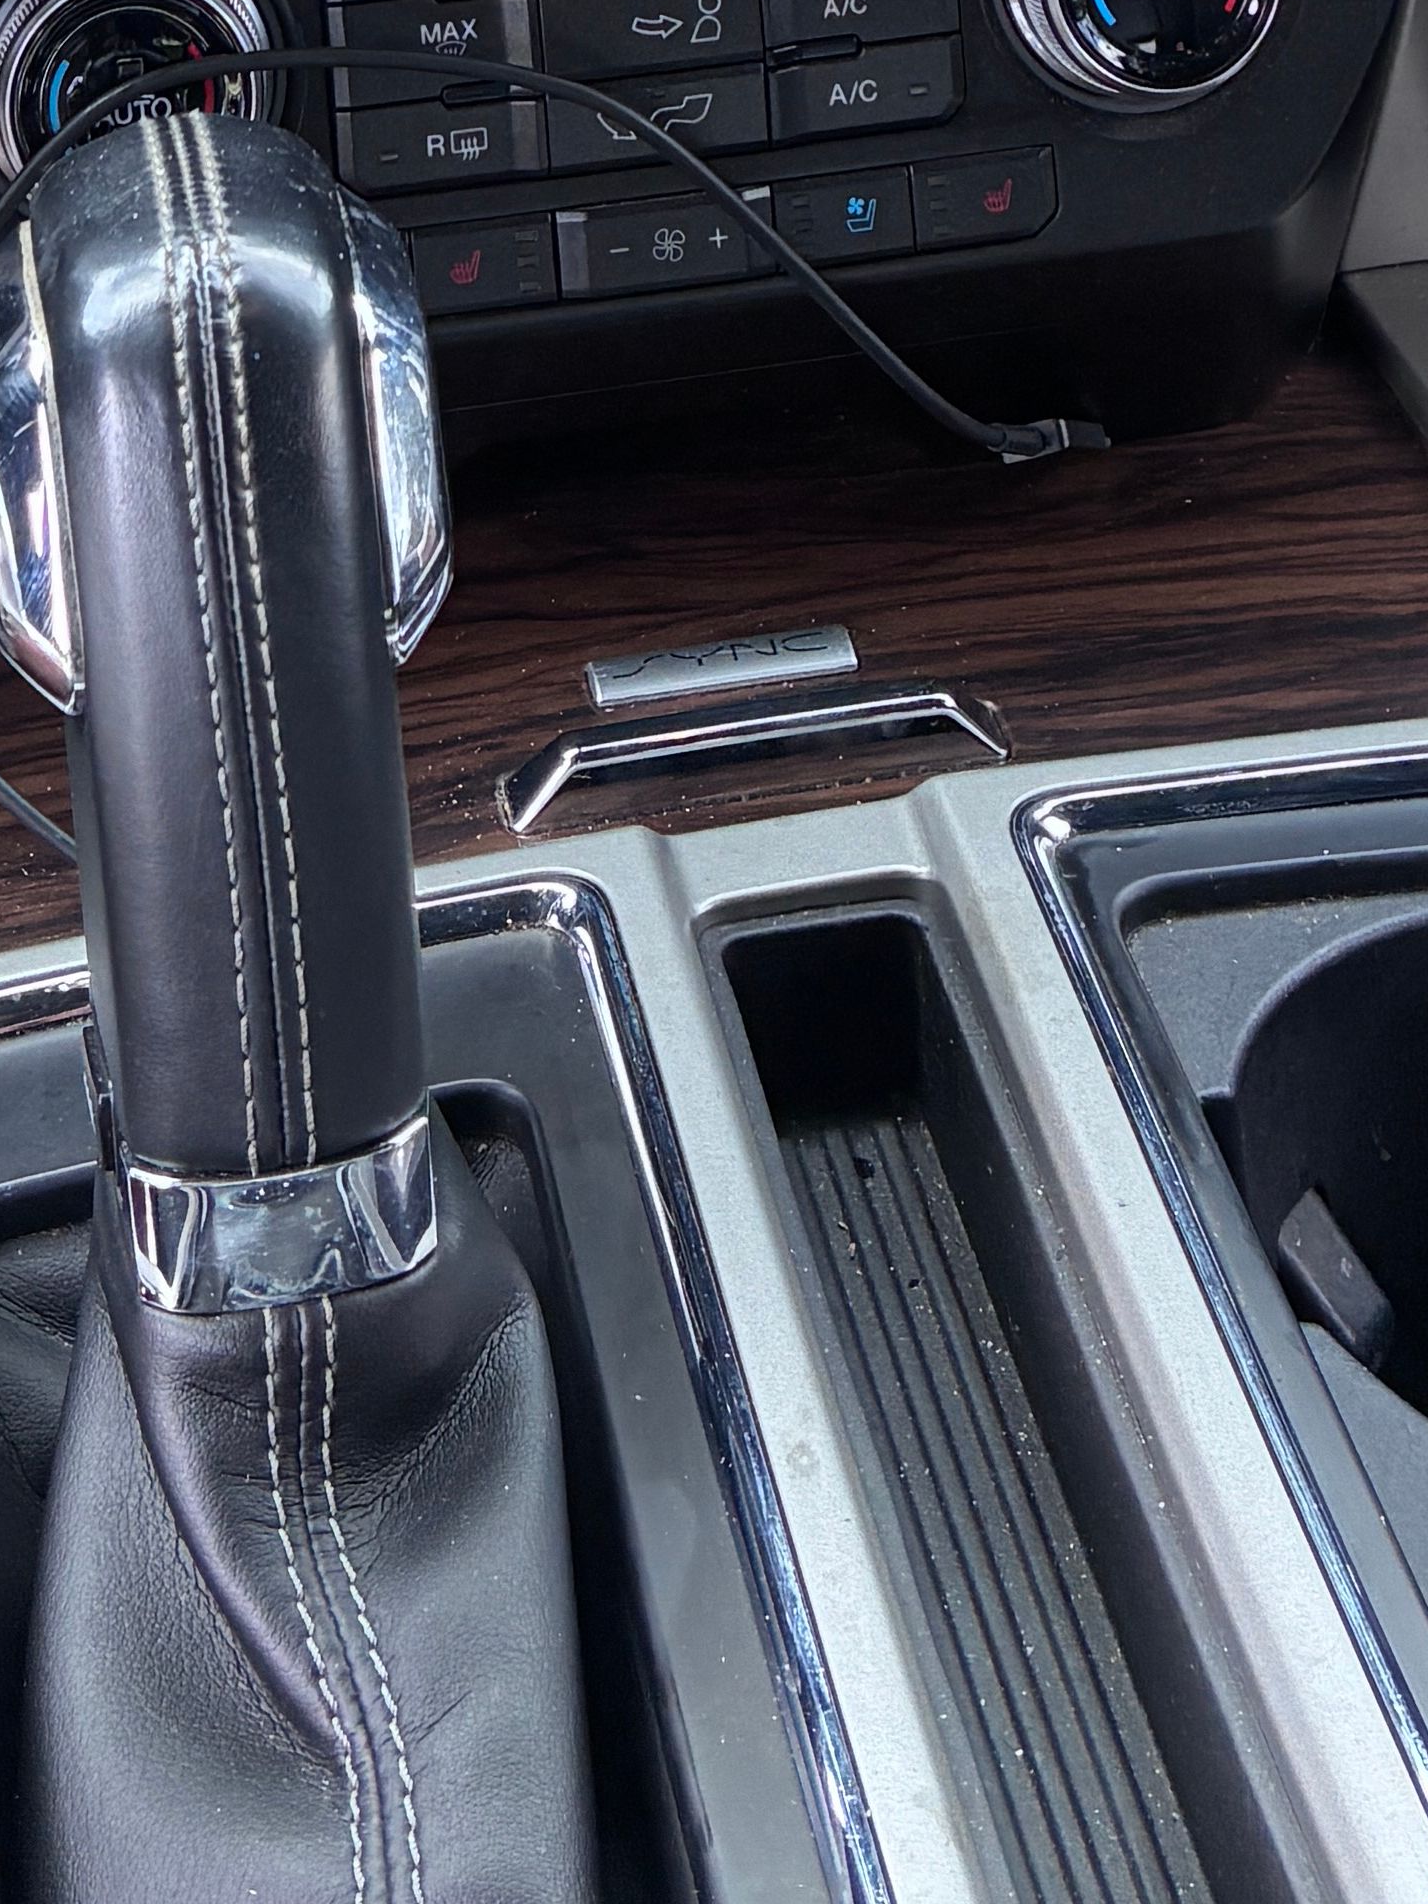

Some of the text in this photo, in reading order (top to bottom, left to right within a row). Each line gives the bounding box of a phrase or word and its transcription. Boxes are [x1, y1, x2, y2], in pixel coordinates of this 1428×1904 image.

[420, 18, 478, 45] MAX
[829, 79, 878, 106] A/C
[427, 134, 445, 158] R
[613, 631, 828, 680] SYNC
